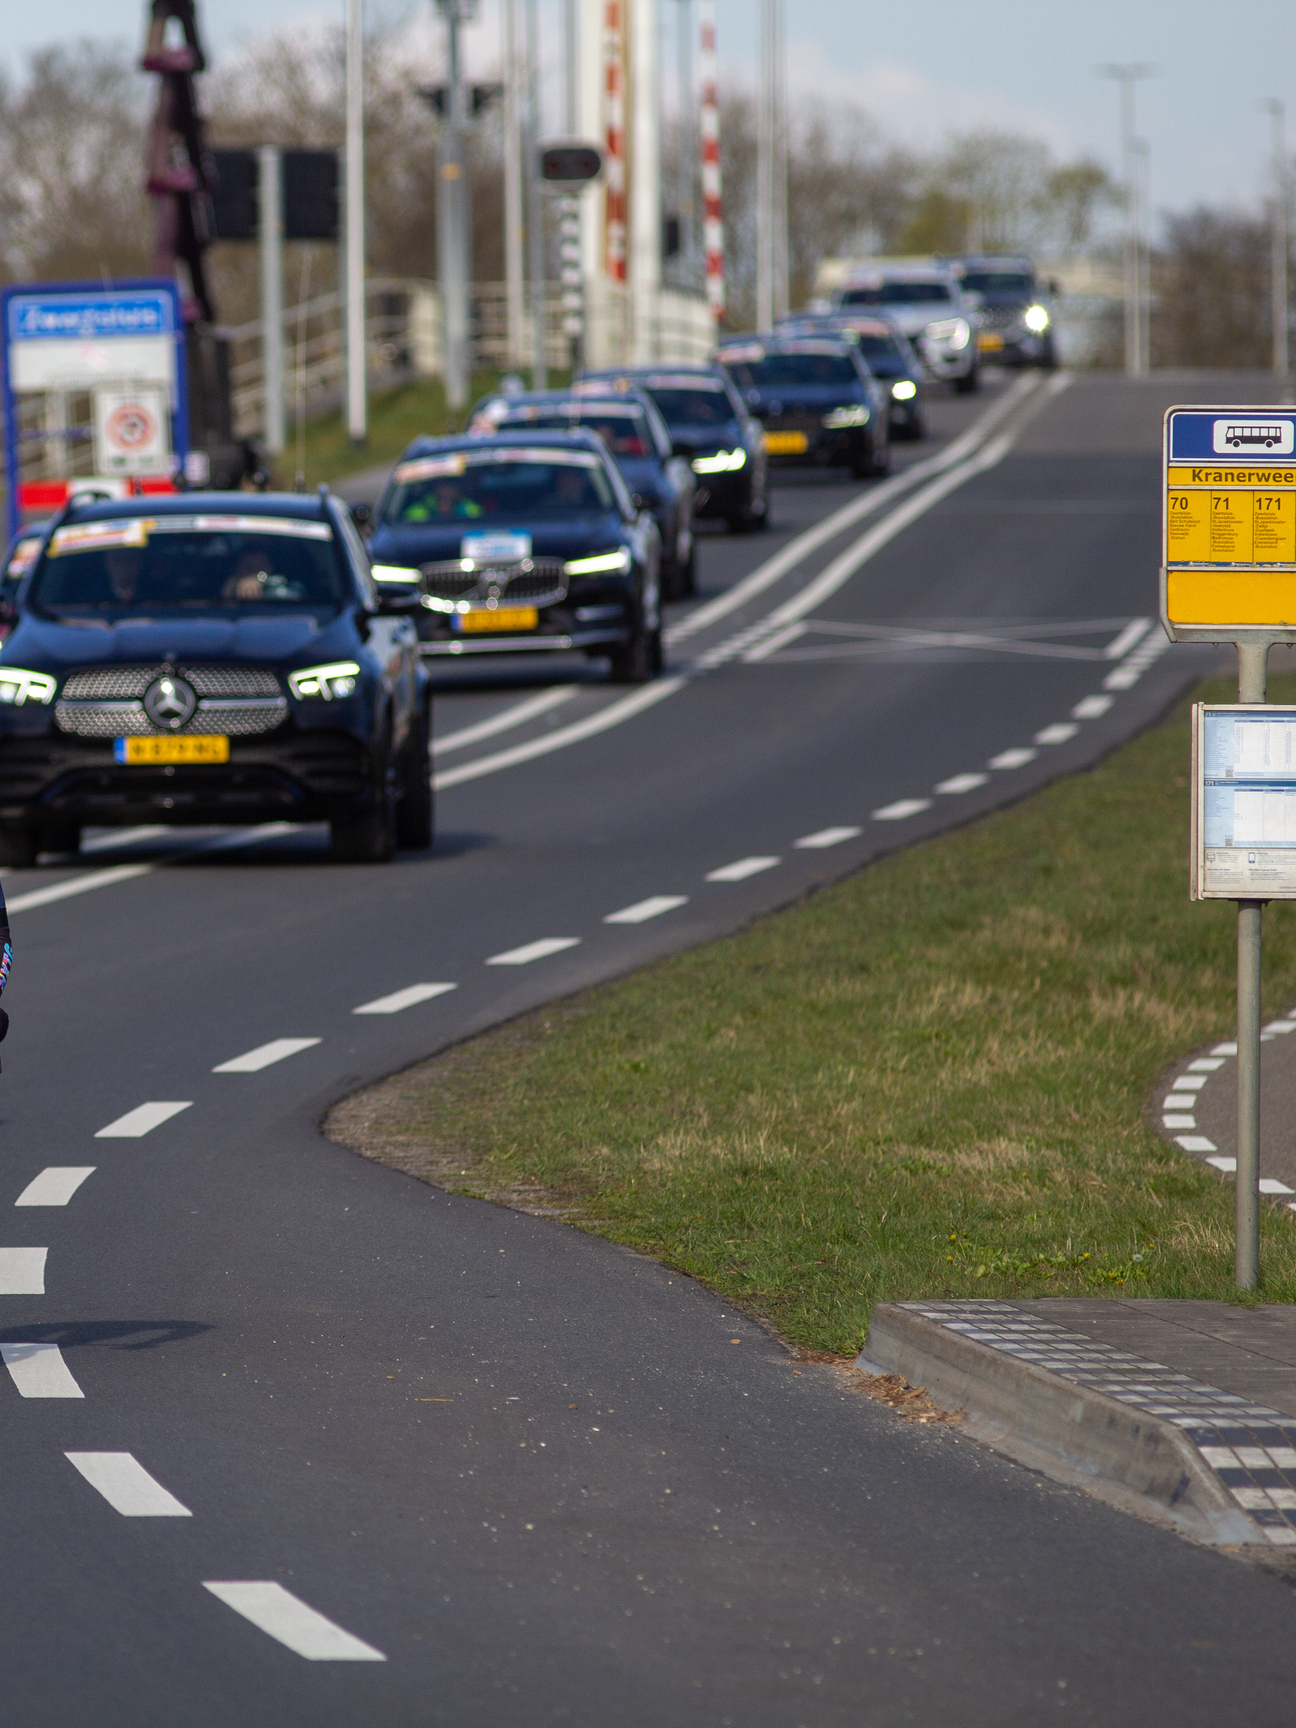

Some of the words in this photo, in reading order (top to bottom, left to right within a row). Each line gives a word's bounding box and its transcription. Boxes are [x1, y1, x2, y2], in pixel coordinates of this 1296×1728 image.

[1192, 469, 1296, 483] Kranerwee
[1170, 497, 1189, 510] 70
[1213, 497, 1229, 510] 71
[1255, 497, 1281, 511] 171
